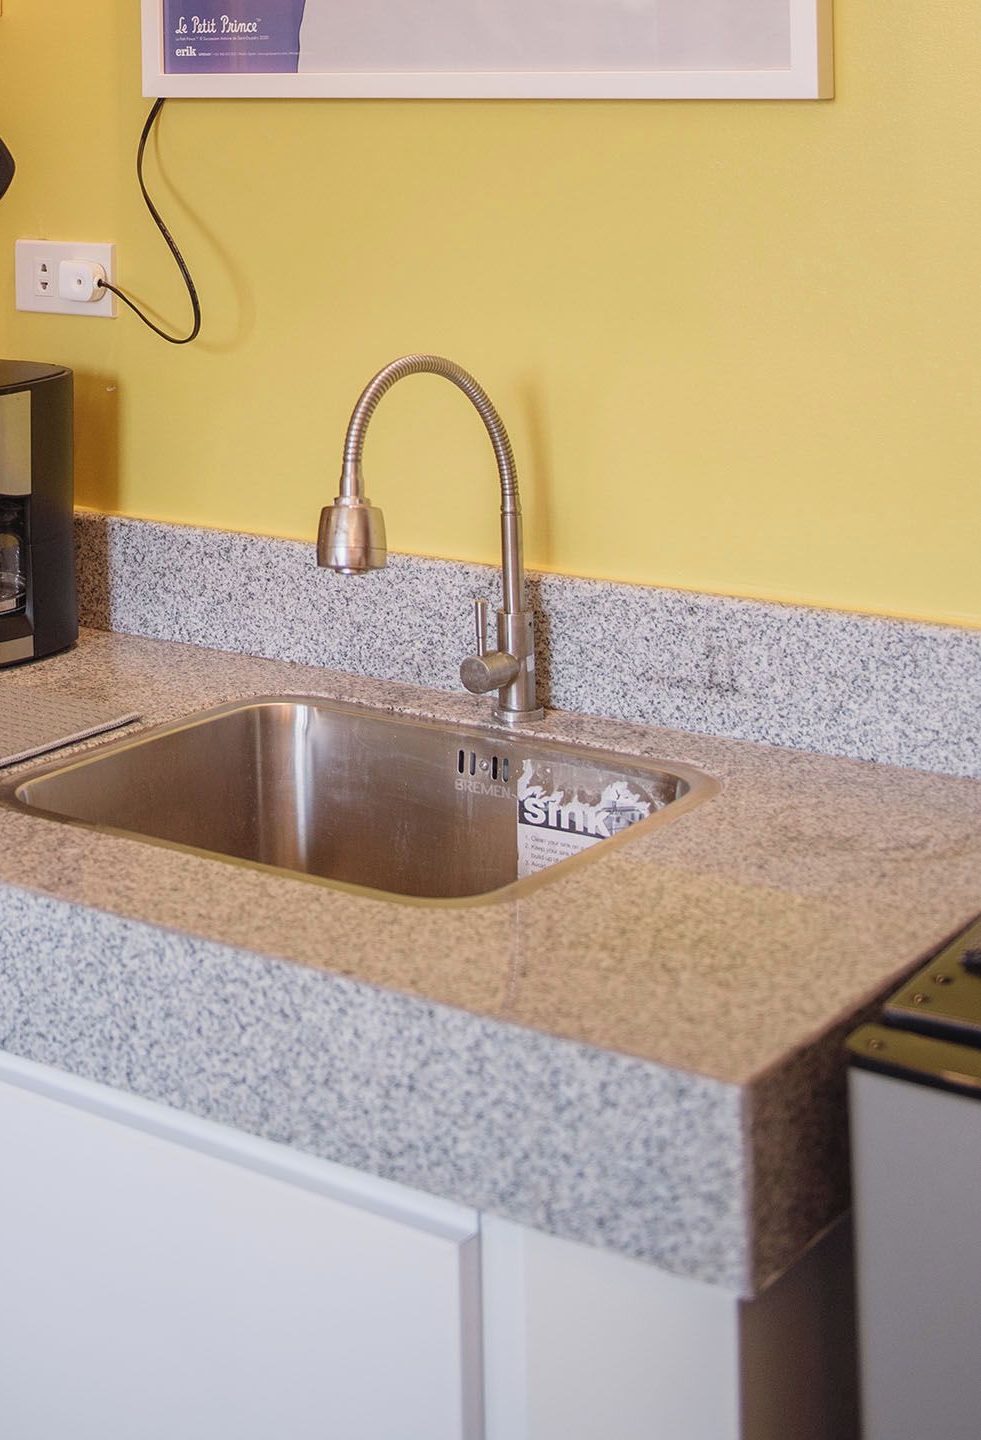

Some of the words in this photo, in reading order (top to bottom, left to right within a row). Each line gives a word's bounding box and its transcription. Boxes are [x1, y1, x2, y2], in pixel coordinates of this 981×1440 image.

[175, 16, 188, 34] Le
[191, 15, 217, 34] Petit
[175, 46, 197, 57] erik
[454, 778, 511, 800] BREMEN
